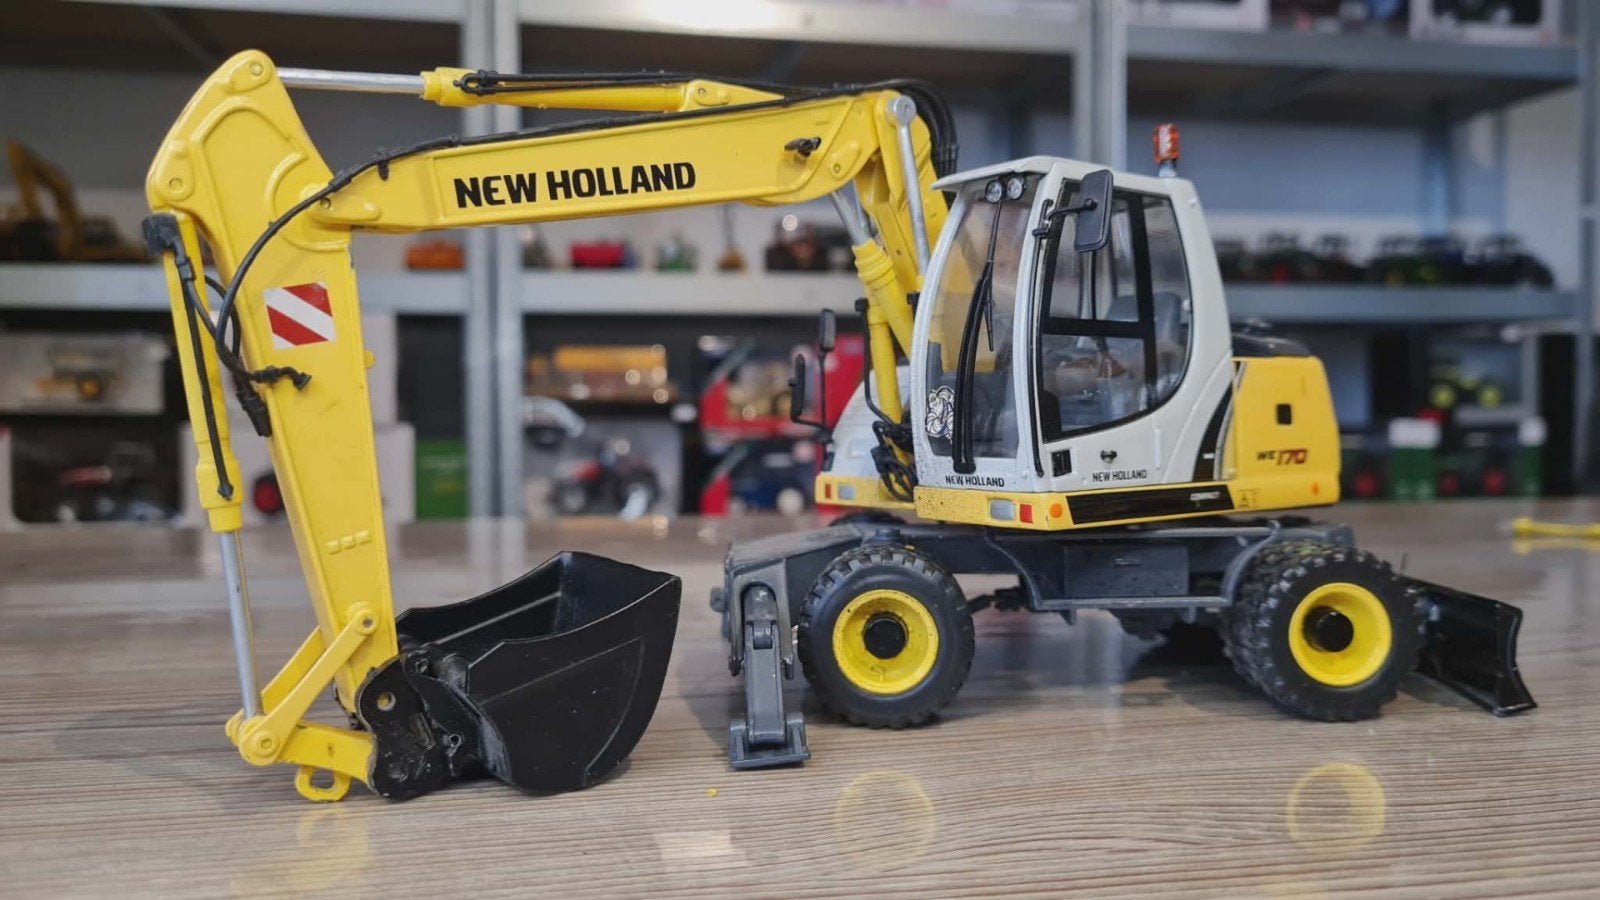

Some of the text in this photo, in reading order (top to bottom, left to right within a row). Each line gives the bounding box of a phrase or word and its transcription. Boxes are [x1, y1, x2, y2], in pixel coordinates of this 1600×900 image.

[454, 162, 695, 208] NEW HOLLAND
[1277, 449, 1307, 466] 170
[945, 475, 1004, 487] NEW HOLLAND
[1092, 469, 1147, 482] NEW HOLLAND
